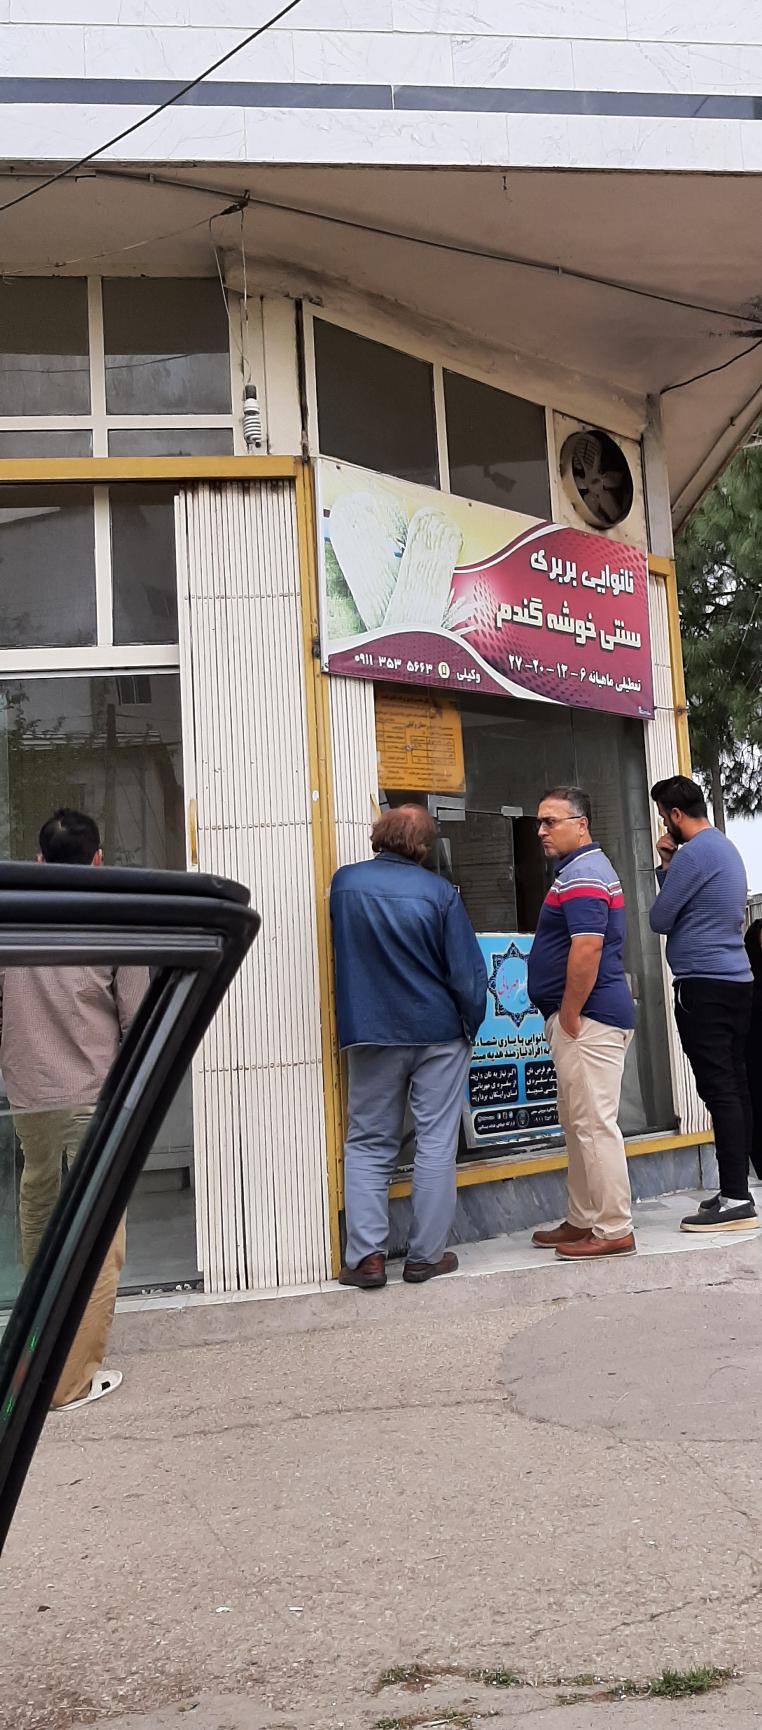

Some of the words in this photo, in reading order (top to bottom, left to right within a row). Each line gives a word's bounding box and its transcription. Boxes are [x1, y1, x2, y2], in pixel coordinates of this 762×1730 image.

[530, 549, 577, 587] بربری
[581, 564, 634, 596] نانوایی
[496, 597, 543, 628] گندم
[546, 600, 597, 645] خوشه
[600, 619, 641, 651] سنتی
[354, 653, 373, 666] ۰۹۱۱
[378, 656, 402, 670] ۳۵۳
[456, 668, 481, 684] وکیلی
[588, 670, 614, 688] ماهیانه
[615, 676, 641, 692] تعطیلی
